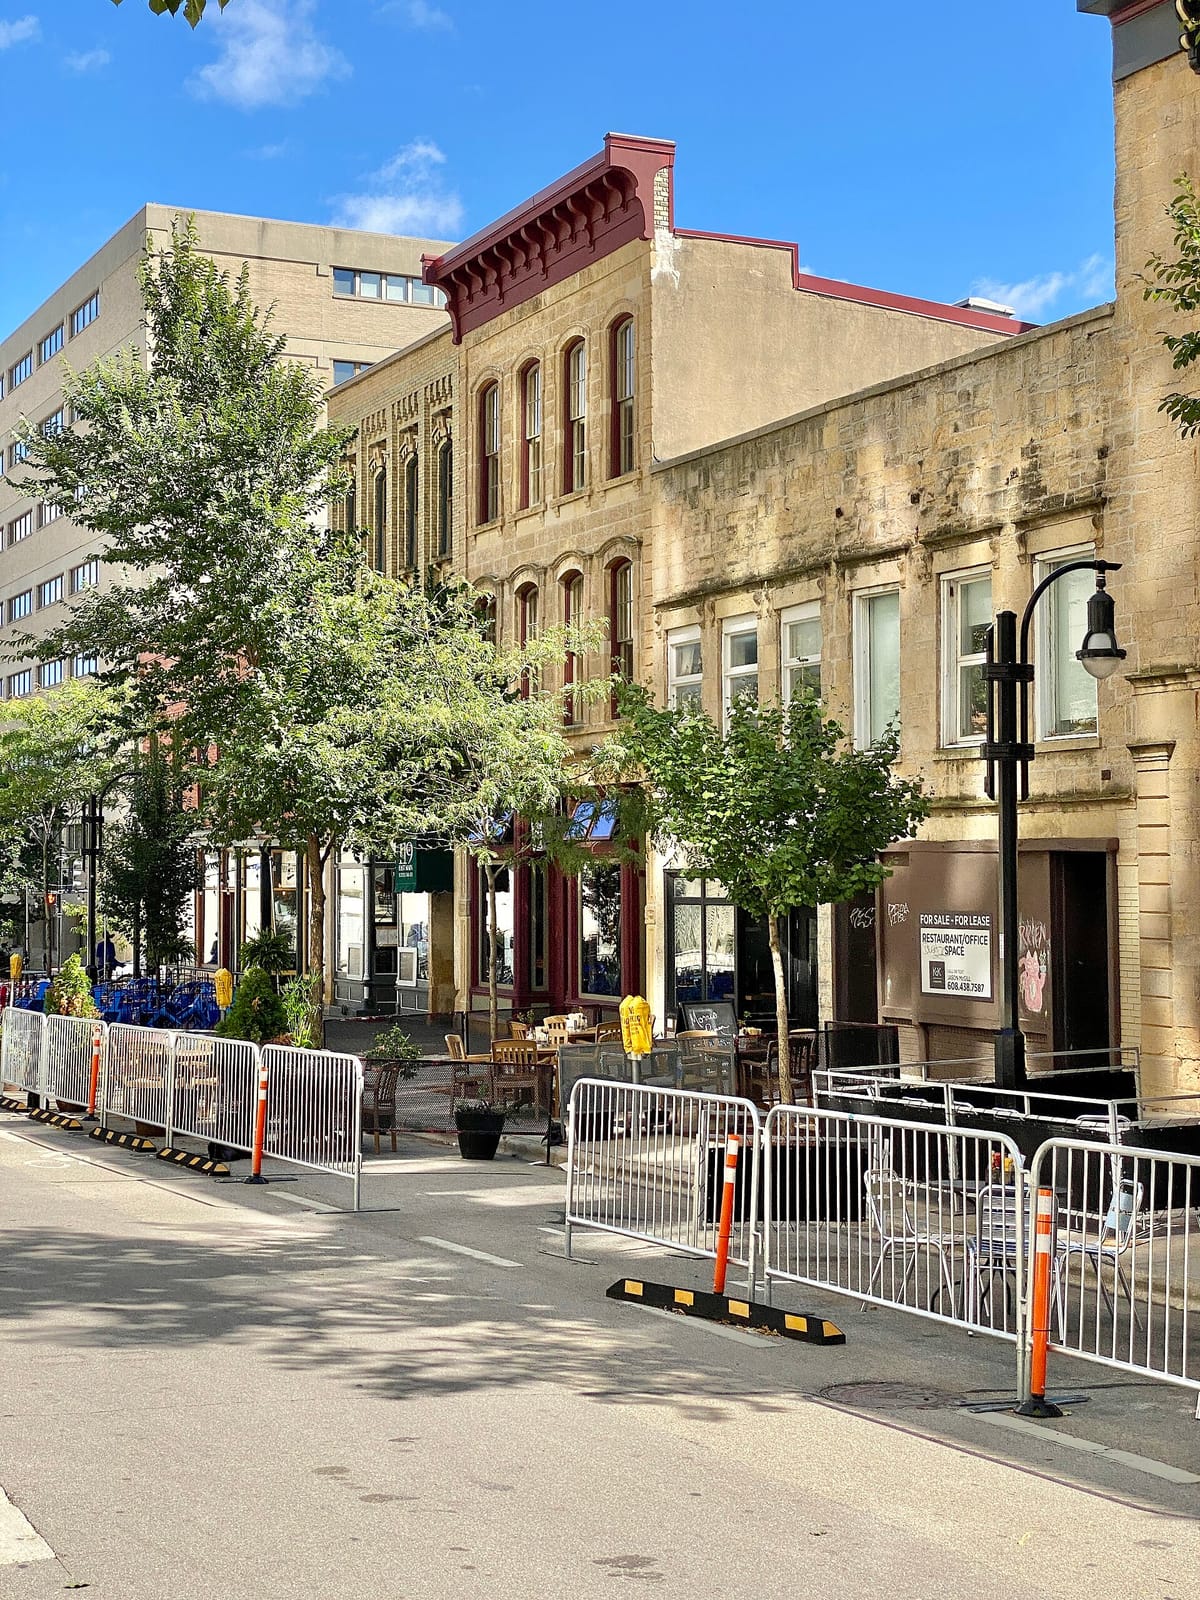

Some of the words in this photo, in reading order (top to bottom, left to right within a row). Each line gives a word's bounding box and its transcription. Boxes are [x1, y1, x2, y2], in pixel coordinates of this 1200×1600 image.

[920, 914, 933, 925] FOR
[934, 914, 950, 925] SALE
[955, 915, 969, 926] FOR
[969, 915, 990, 927] LEASE
[922, 933, 988, 945] RESTAURANT/OFFICE
[944, 945, 965, 956] SPACE
[947, 981, 984, 992] 608.438.7587
